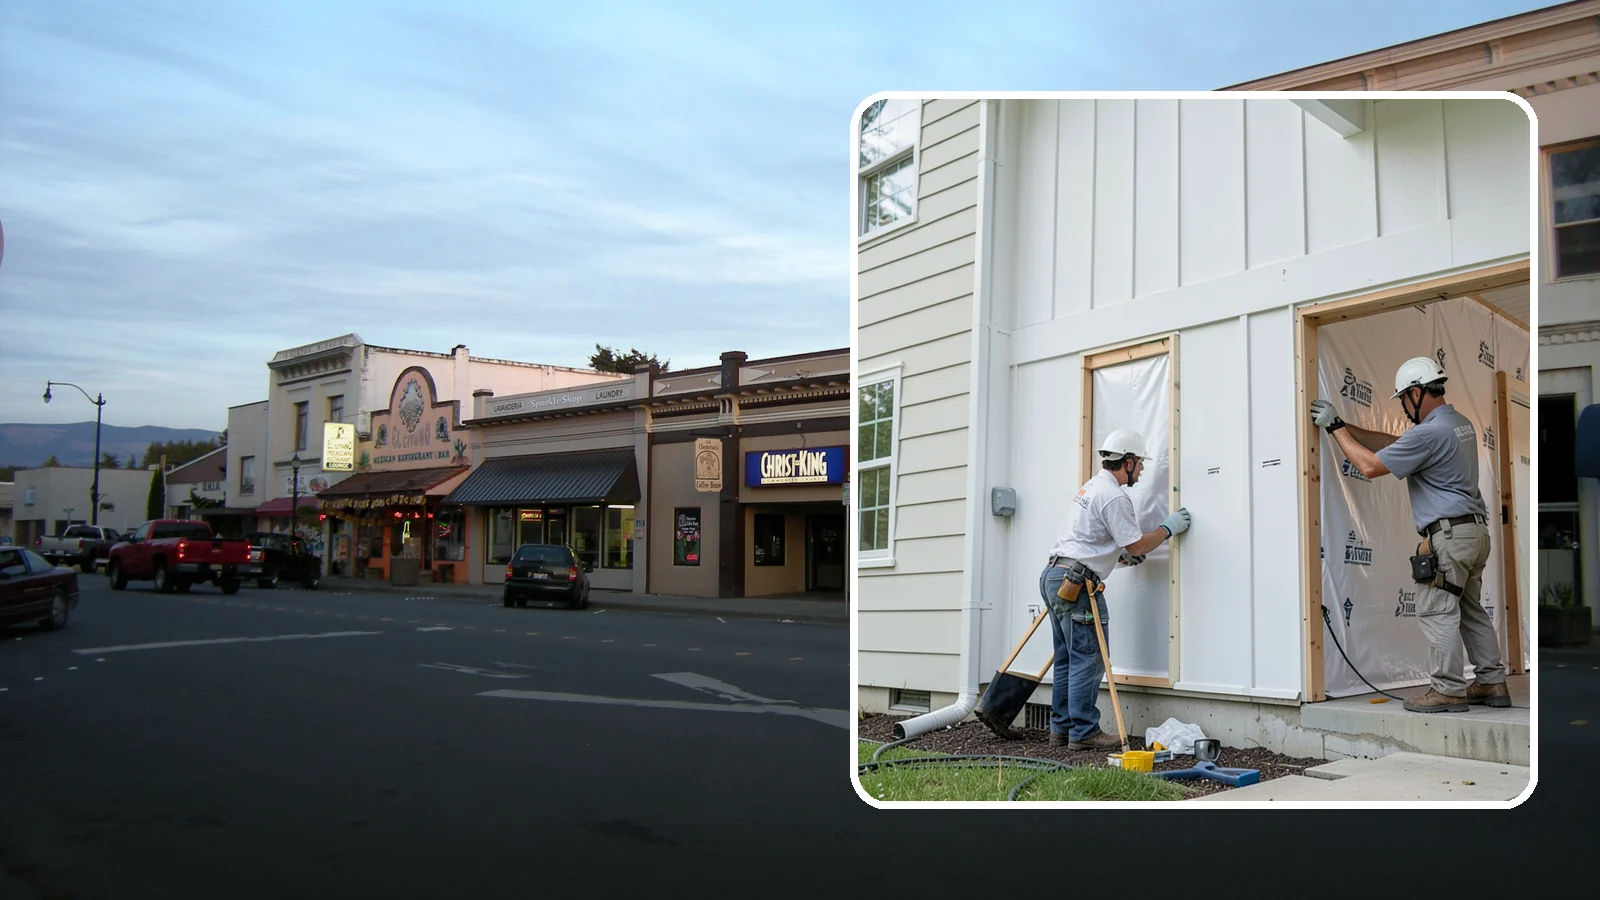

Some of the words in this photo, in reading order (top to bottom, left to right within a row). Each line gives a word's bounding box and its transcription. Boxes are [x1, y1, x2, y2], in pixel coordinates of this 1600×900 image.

[494, 402, 522, 412] LAVANDERIA
[530, 397, 562, 409] Sparkle
[562, 395, 583, 404] Shop
[596, 389, 623, 399] LAUNDRY
[397, 451, 433, 462] RESTAURANT
[438, 450, 450, 459] BAR
